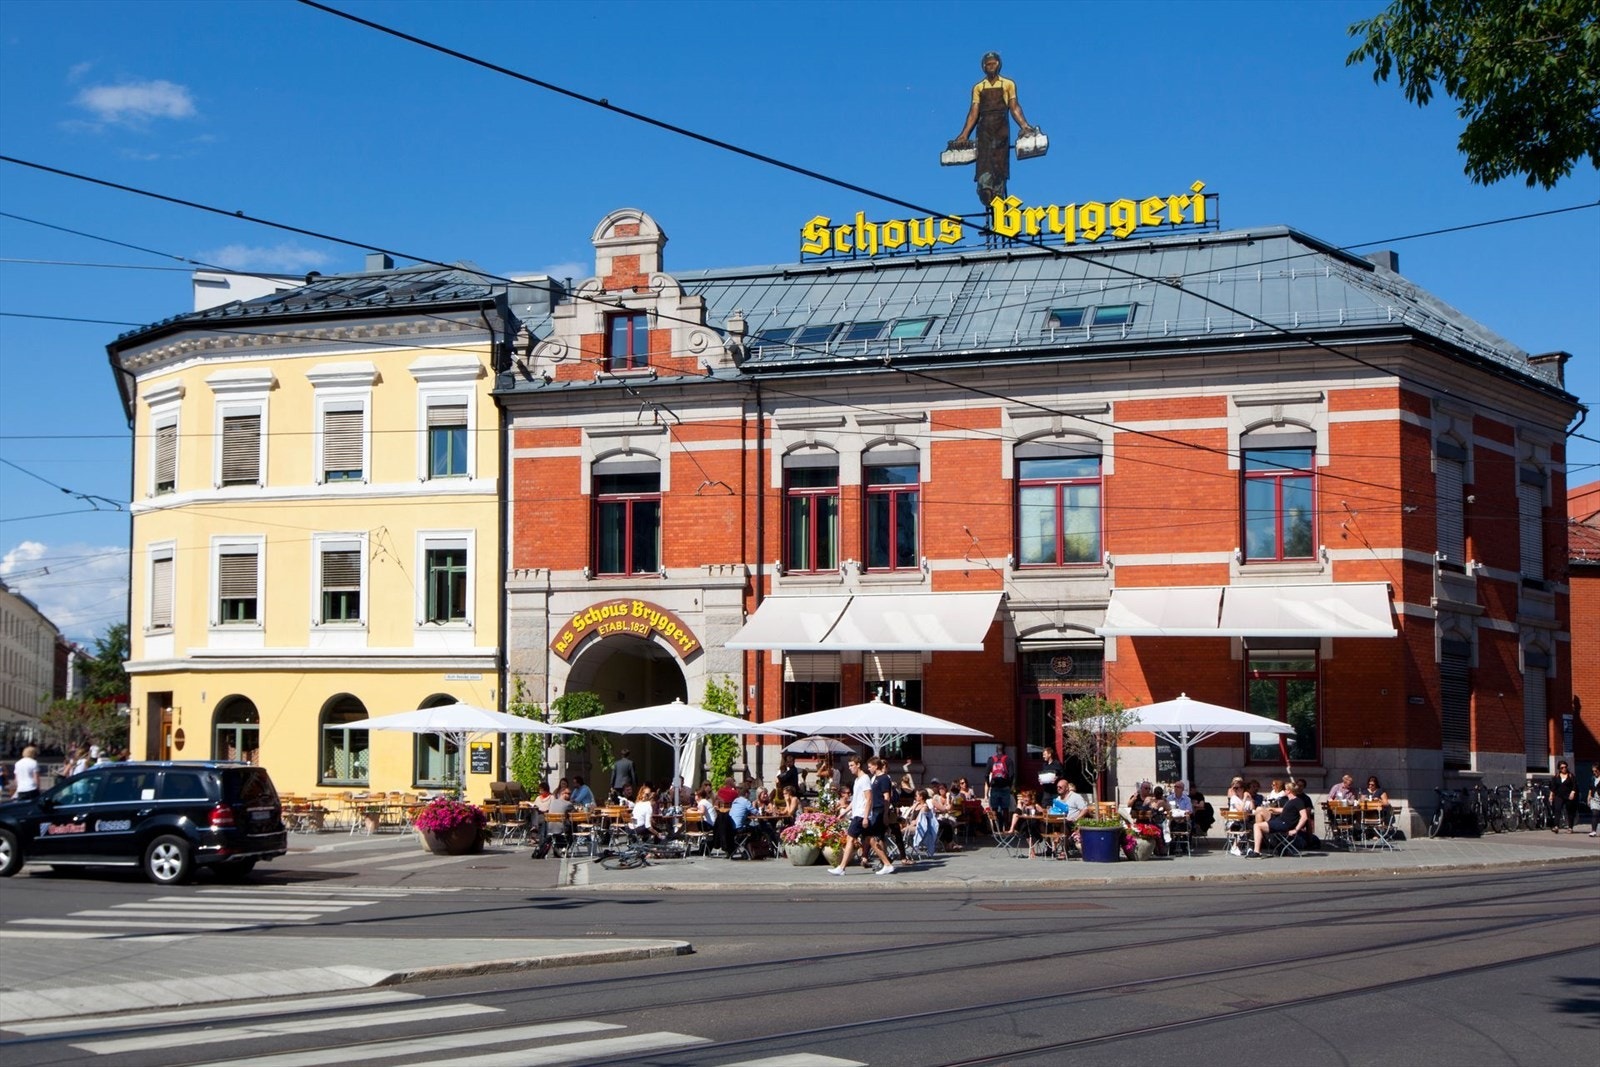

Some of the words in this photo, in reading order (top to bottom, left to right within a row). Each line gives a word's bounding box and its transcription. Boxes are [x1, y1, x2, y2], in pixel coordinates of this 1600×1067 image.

[802, 211, 964, 256] Schous
[990, 180, 1207, 243] Bryggeri
[572, 603, 629, 632] Schous
[631, 600, 697, 652] Bryggeri
